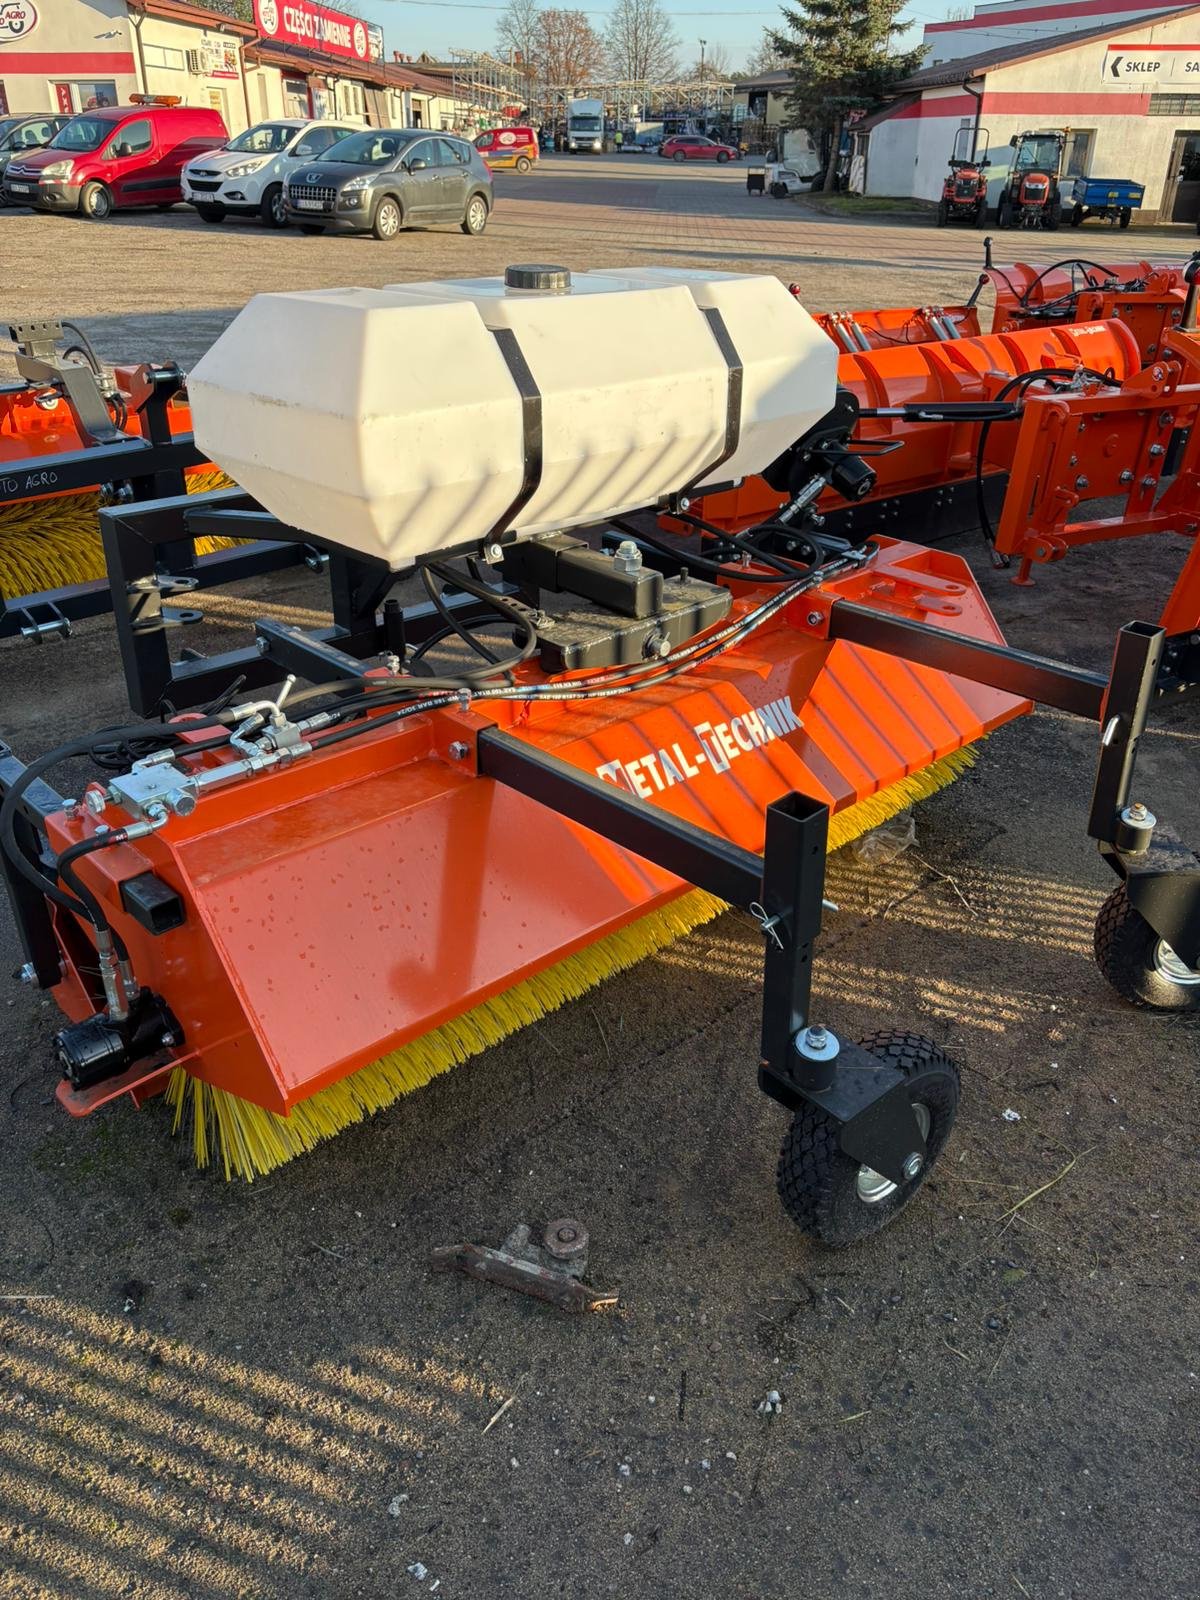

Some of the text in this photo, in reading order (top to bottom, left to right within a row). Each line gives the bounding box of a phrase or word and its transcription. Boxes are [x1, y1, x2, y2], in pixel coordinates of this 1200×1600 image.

[5, 11, 26, 20] AGRO
[283, 4, 313, 42] CZĘŚCI
[313, 15, 352, 48] ZAMIENNE
[1125, 62, 1160, 72] SKLEP
[25, 471, 58, 489] AGRO
